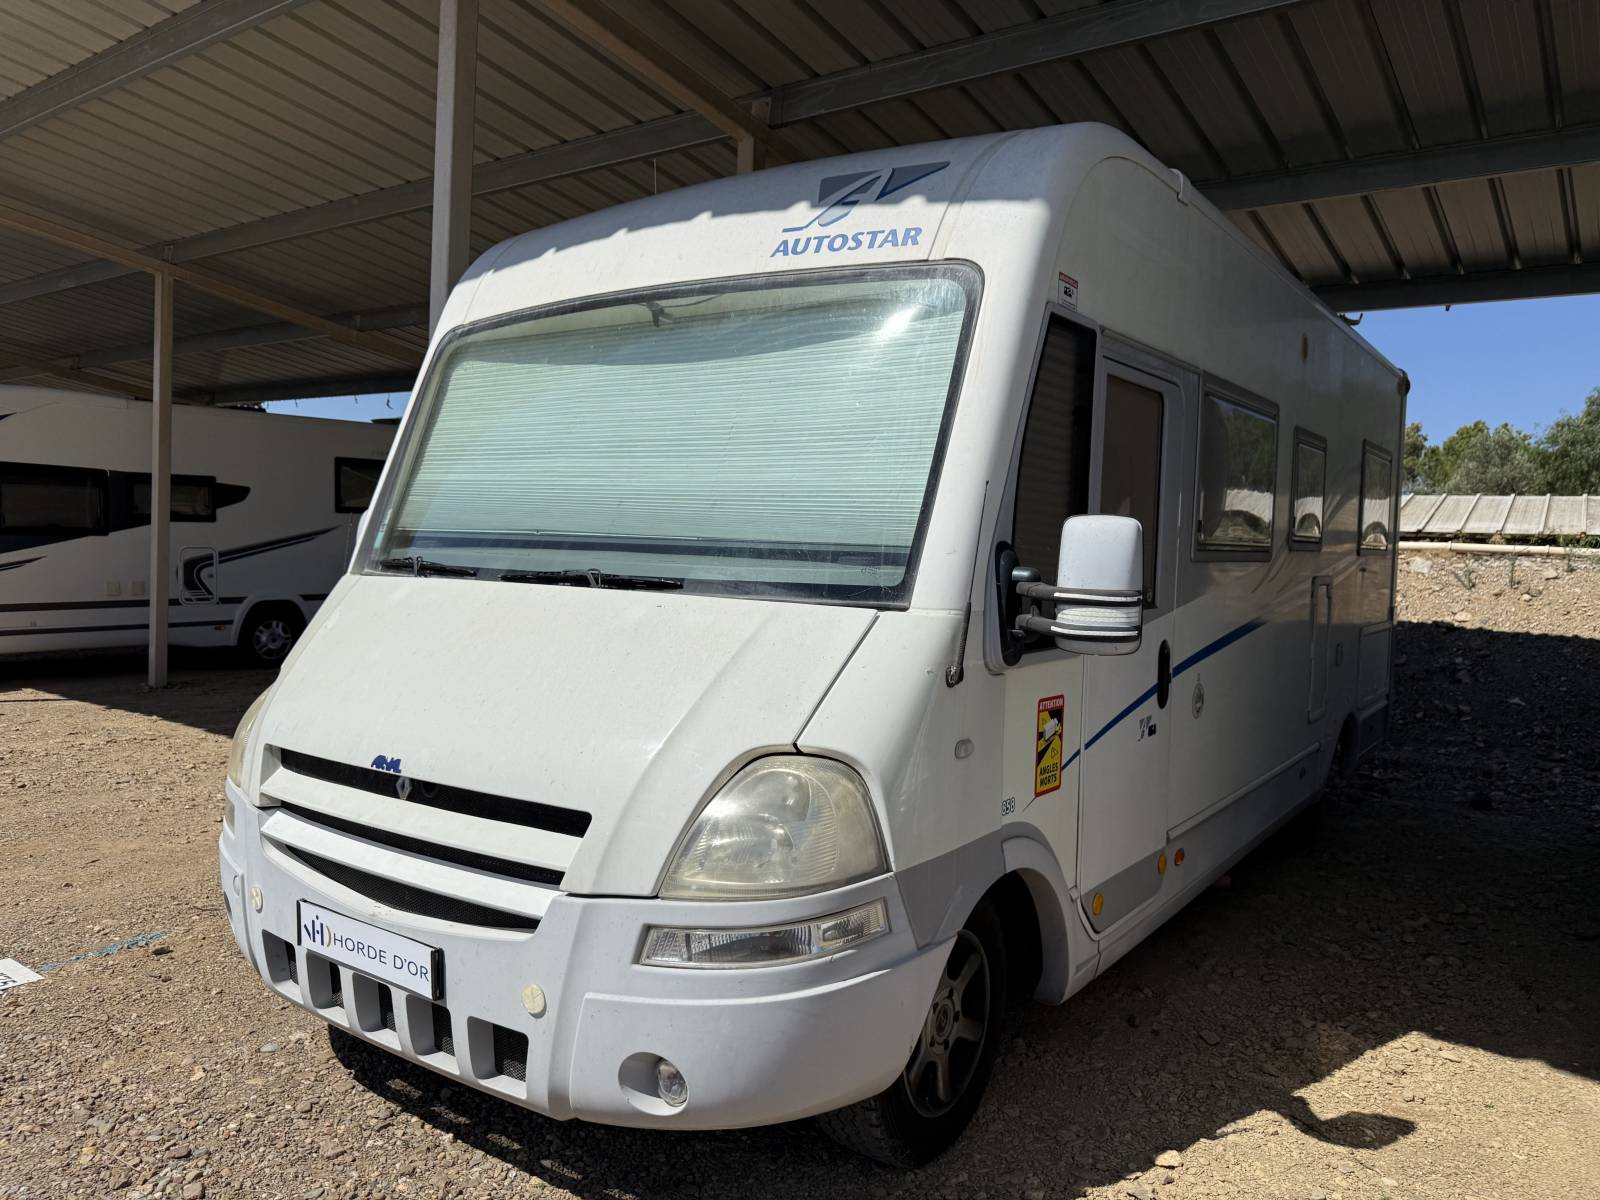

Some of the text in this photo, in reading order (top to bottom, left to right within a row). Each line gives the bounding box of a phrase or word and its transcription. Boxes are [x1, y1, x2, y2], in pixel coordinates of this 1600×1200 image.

[769, 226, 923, 258] AUTOSTAR
[1039, 762, 1059, 776] ANGLES
[1039, 773, 1057, 787] MORTS
[333, 932, 430, 983] HORDE D'OR
